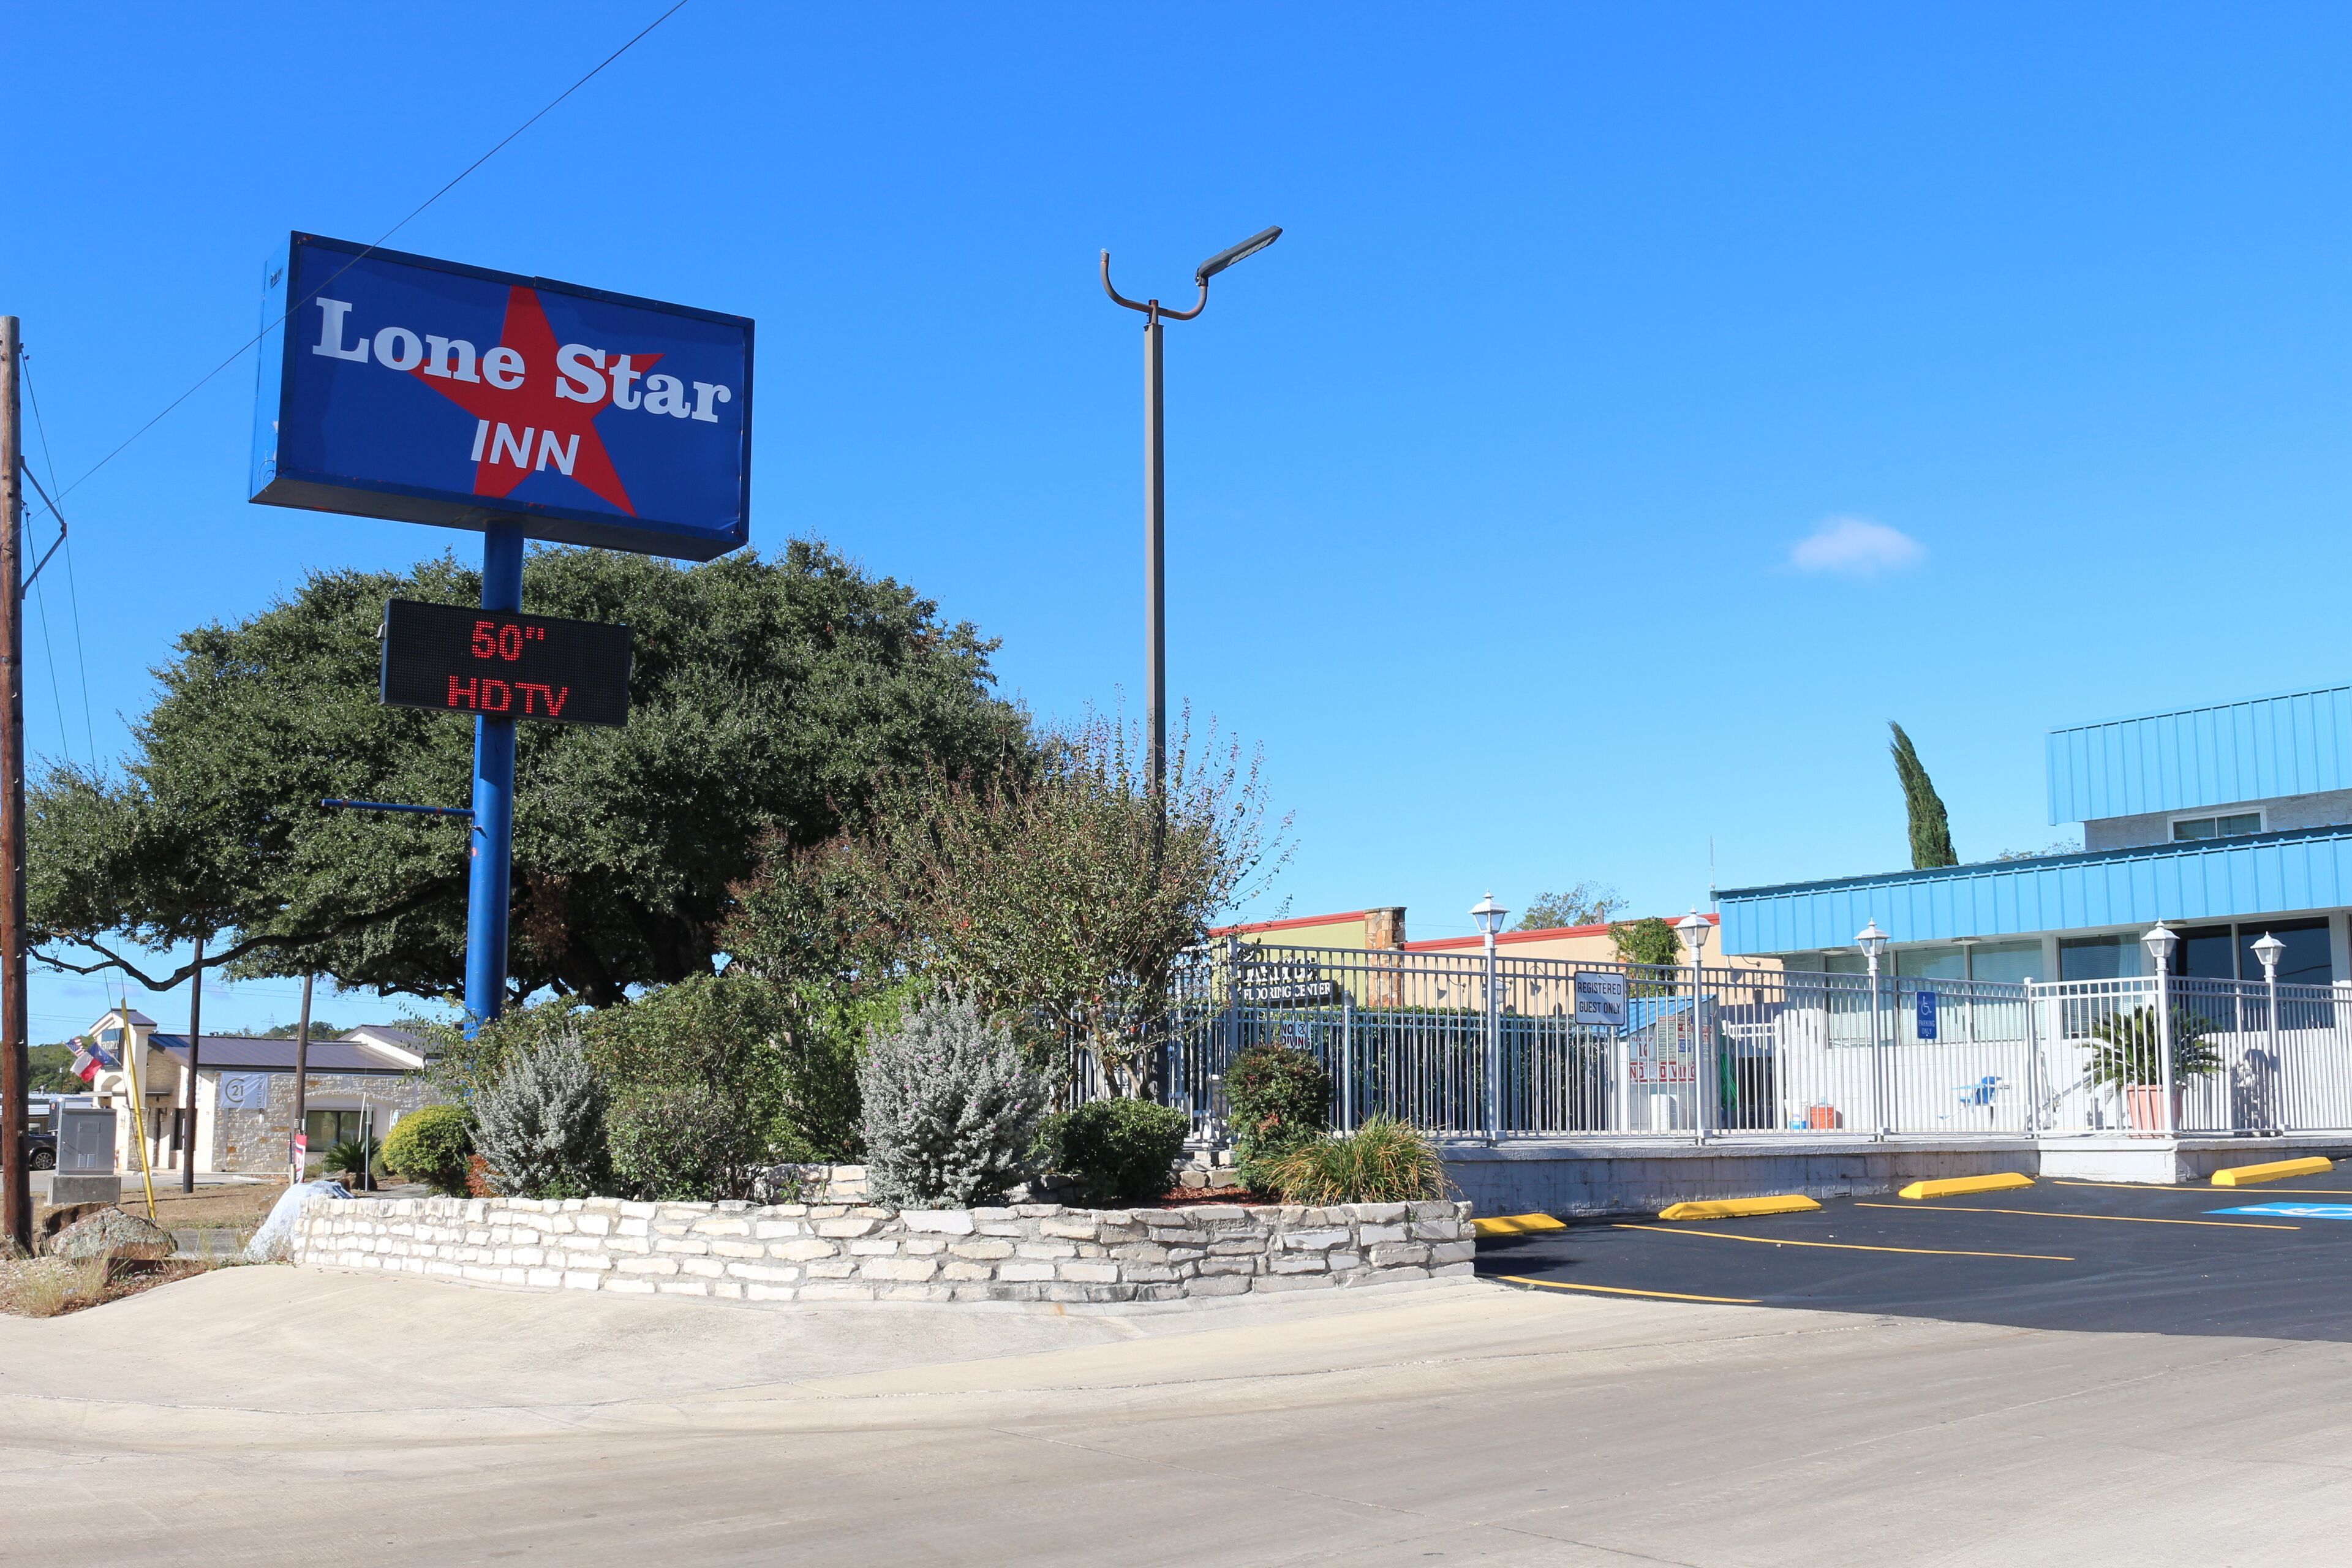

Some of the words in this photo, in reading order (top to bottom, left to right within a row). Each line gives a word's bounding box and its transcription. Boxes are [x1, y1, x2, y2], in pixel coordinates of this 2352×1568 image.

[312, 297, 526, 390] Lone
[556, 342, 731, 423] Star
[471, 419, 579, 476] INN
[448, 676, 569, 716] HDTV
[1243, 986, 1291, 1000] FLOORING
[1294, 982, 1330, 997] CENTER
[1577, 982, 1621, 995] REGISTERED
[1579, 1001, 1601, 1013] GUEST
[1604, 1002, 1621, 1014] ONLY
[1282, 1023, 1293, 1035] NO
